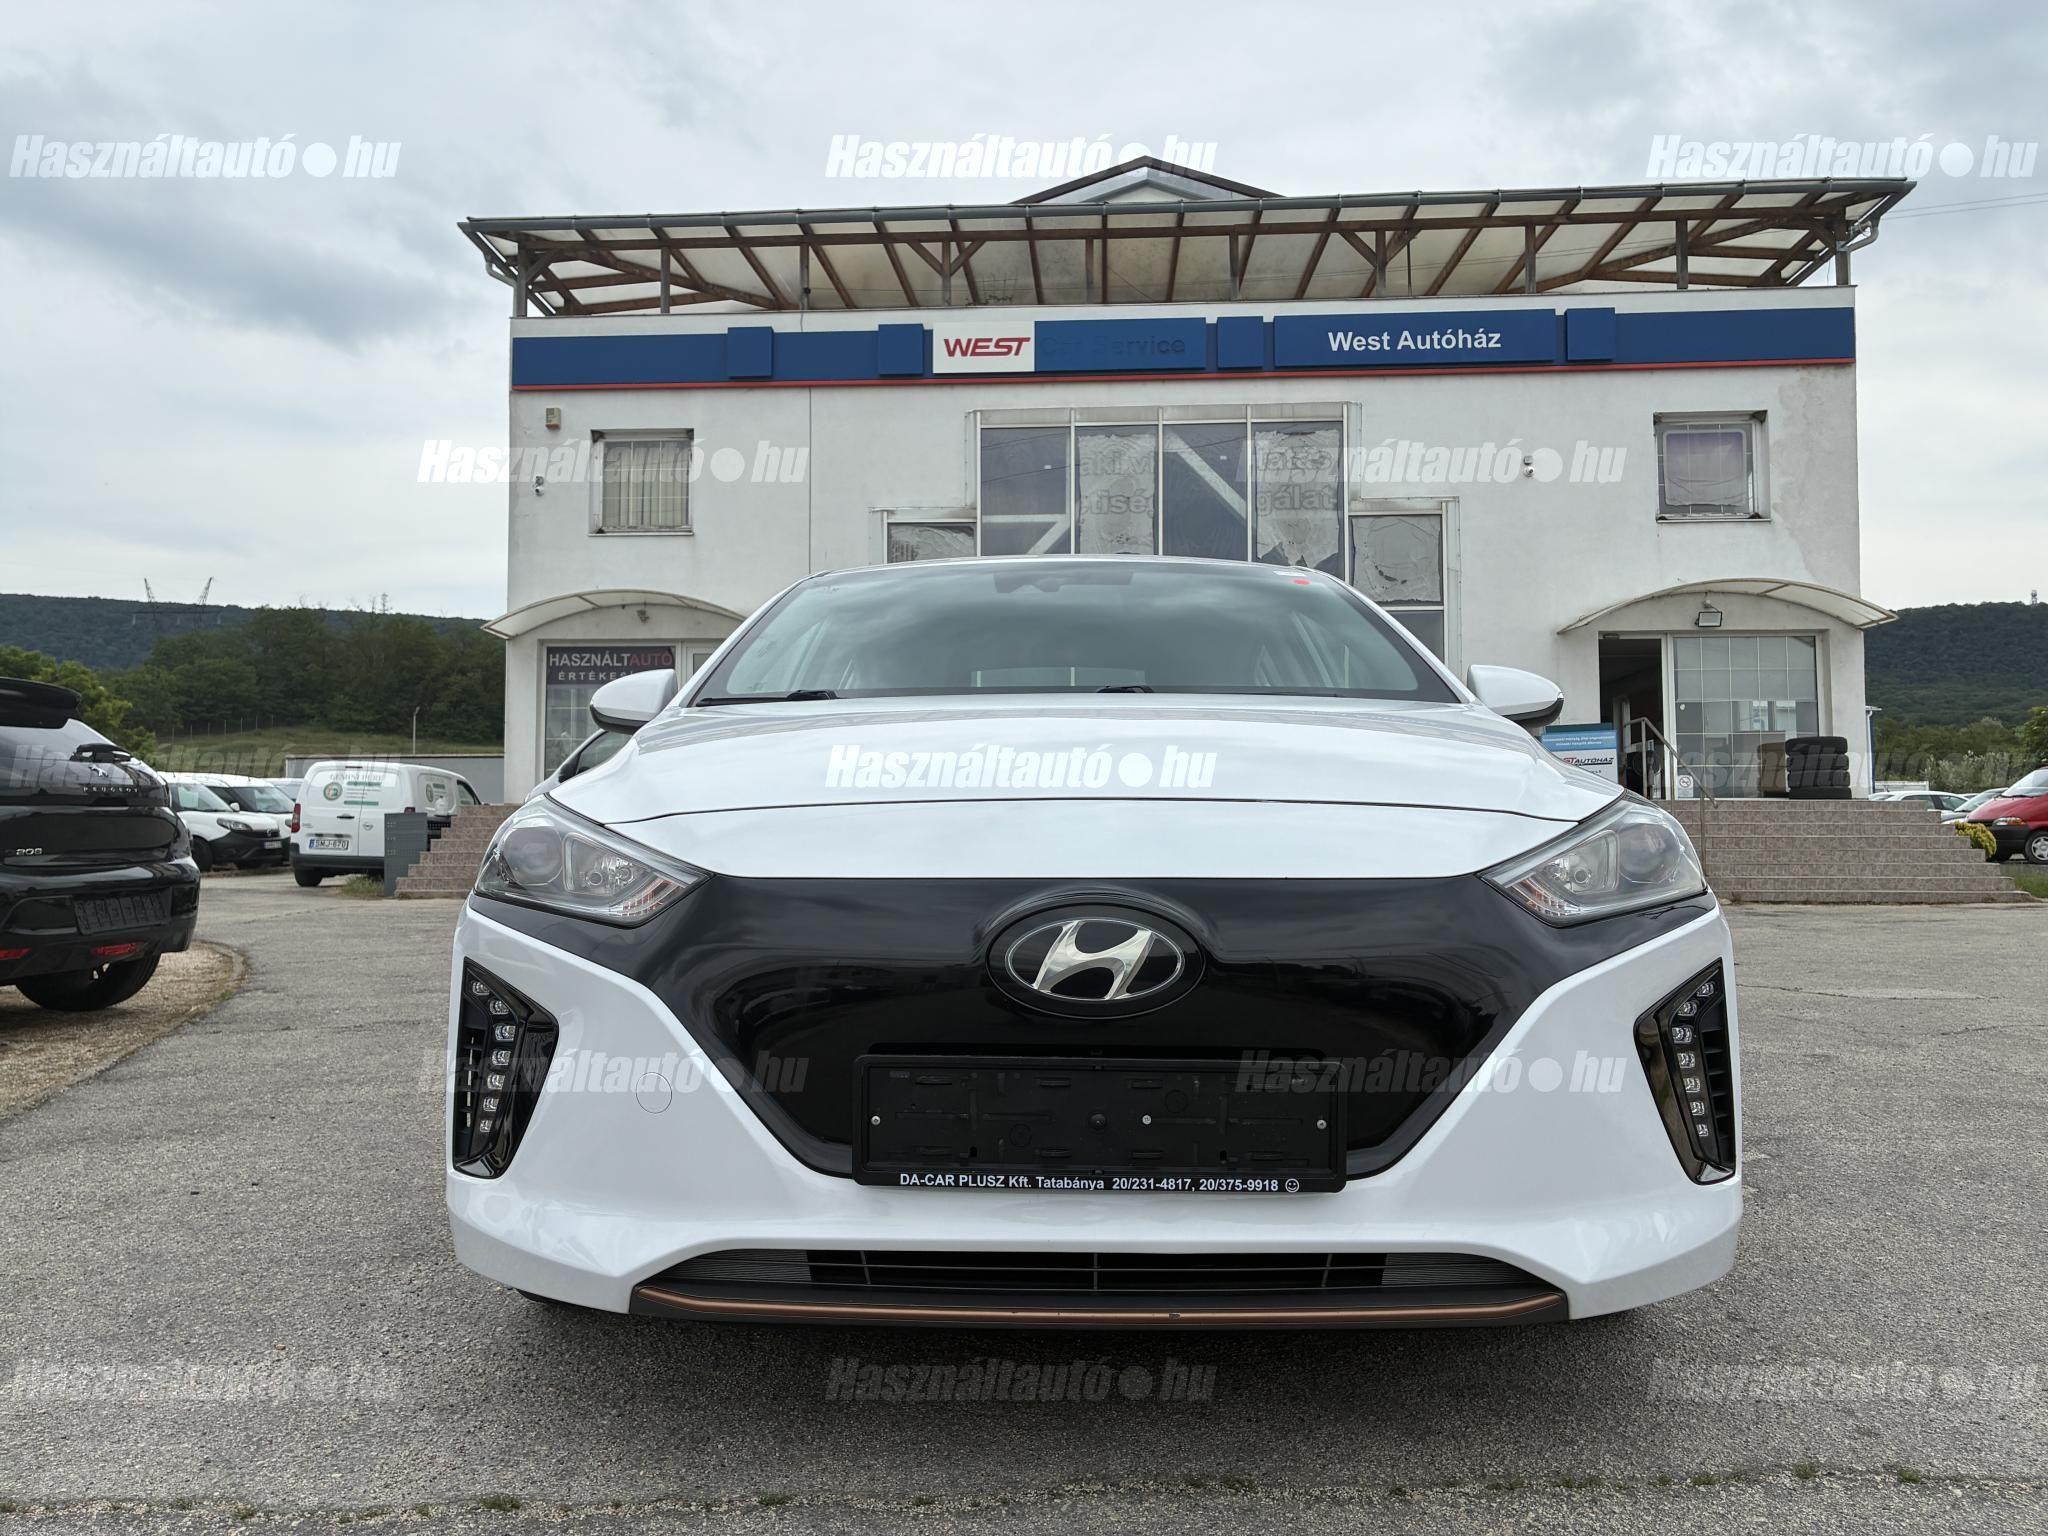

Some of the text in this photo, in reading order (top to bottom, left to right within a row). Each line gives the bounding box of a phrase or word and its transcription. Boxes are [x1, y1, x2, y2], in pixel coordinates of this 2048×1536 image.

[943, 337, 1030, 357] WEST
[1328, 328, 1502, 351] West Autóház
[900, 1173, 1279, 1192] DA-CAR PLUSZ Kft. Tatabánya 20/231-4817, 20/375-9918
